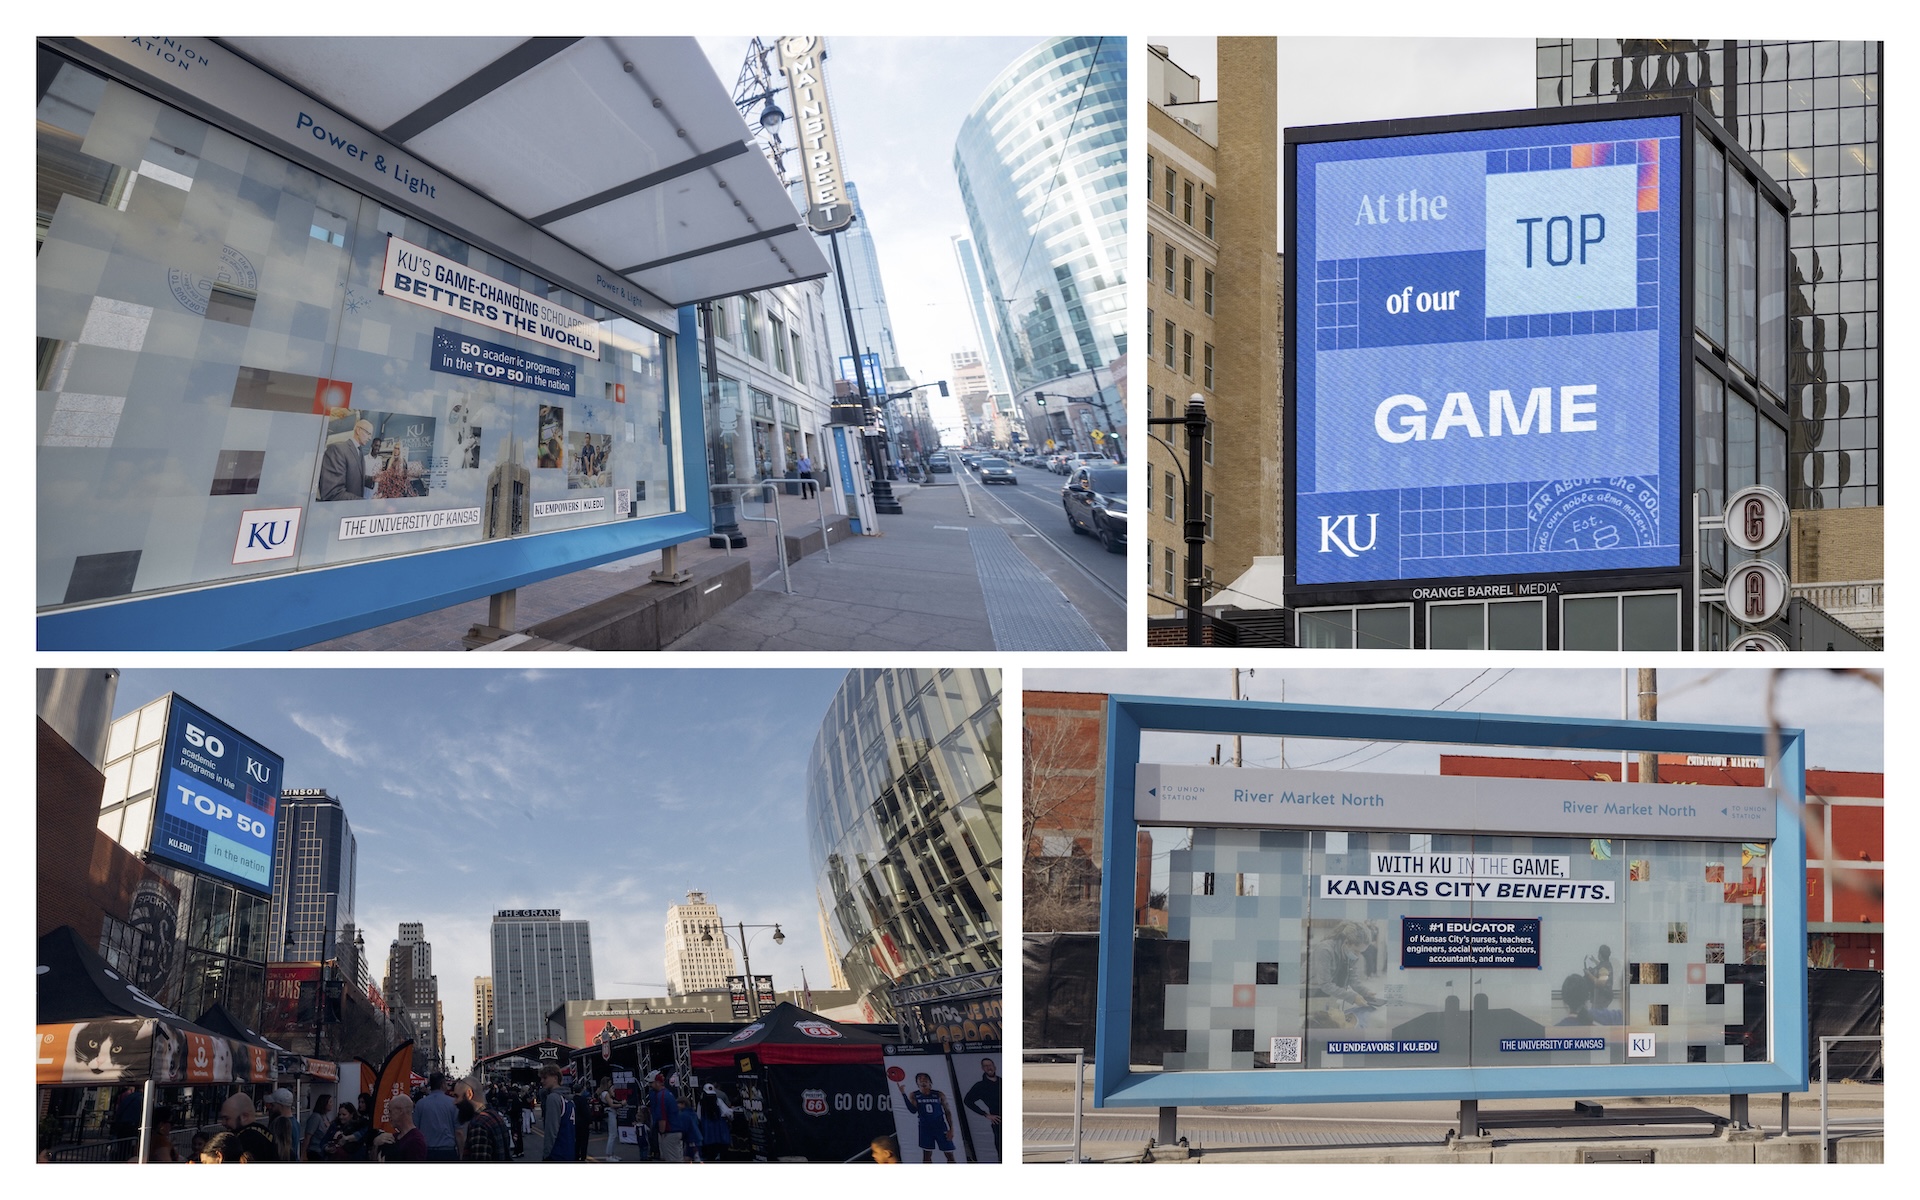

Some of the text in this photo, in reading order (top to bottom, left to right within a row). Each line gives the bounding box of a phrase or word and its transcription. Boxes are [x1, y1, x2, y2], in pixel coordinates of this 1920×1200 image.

[123, 36, 189, 70] ATION
[296, 112, 436, 199] Power & Light
[1354, 188, 1448, 226] At the
[1516, 213, 1606, 268] TOP
[397, 249, 432, 277] KU'S
[435, 264, 539, 317] GAME-CHANGING
[596, 274, 619, 295] Power
[627, 291, 643, 308] Light
[1385, 285, 1460, 315] of our
[394, 272, 596, 353] BETTERS THE WORLD.
[461, 341, 561, 377] 50 academic programs
[442, 354, 570, 392] in the TOP 50 in the nation
[1374, 384, 1598, 444] GAME
[406, 423, 426, 438] KU
[535, 500, 604, 515] KU EMPOWERS KU.EDU
[1528, 492, 1553, 523] FAR
[1609, 477, 1636, 493] the
[1562, 493, 1594, 513] noble
[1597, 492, 1622, 507] alma
[345, 510, 480, 536] THE UNIVERSITY OF KANSAS
[1572, 515, 1603, 533] Est.
[247, 520, 290, 550] KU
[1317, 513, 1381, 558] KU
[1412, 587, 1465, 600] ORANGE
[1467, 585, 1514, 598] BARREL
[185, 722, 225, 758] 50
[181, 747, 217, 770] academic
[246, 755, 271, 784] KU
[180, 757, 236, 791] programs in the
[281, 788, 321, 796] TINSON
[1234, 789, 1385, 807] River Market North
[177, 784, 266, 839] TOP 50
[1563, 801, 1696, 817] River Market North
[168, 837, 193, 854] KU.EDU
[214, 845, 265, 874] in the nation
[1377, 855, 1565, 878] WITH KU IN THE GAME,
[1327, 879, 1611, 900] KANSAS CITY BENEFITS.
[498, 909, 560, 918] THE GRAND
[1409, 934, 1534, 945] of Kansas City's nurses, teachers,
[1428, 923, 1516, 933] #1 EDUCATOR
[1406, 945, 1537, 954] engineers, social workers, doctors,
[1428, 955, 1478, 964] accountants,
[1479, 955, 1494, 963] and
[1329, 1042, 1438, 1052] KU ENDEAVORS KU.EDU
[1502, 1039, 1604, 1050] THE UNIVERSITY OF KANSAS
[1633, 1039, 1652, 1053] KU
[808, 1101, 823, 1110] 66
[834, 1093, 853, 1111] GO
[856, 1093, 874, 1111] GO
